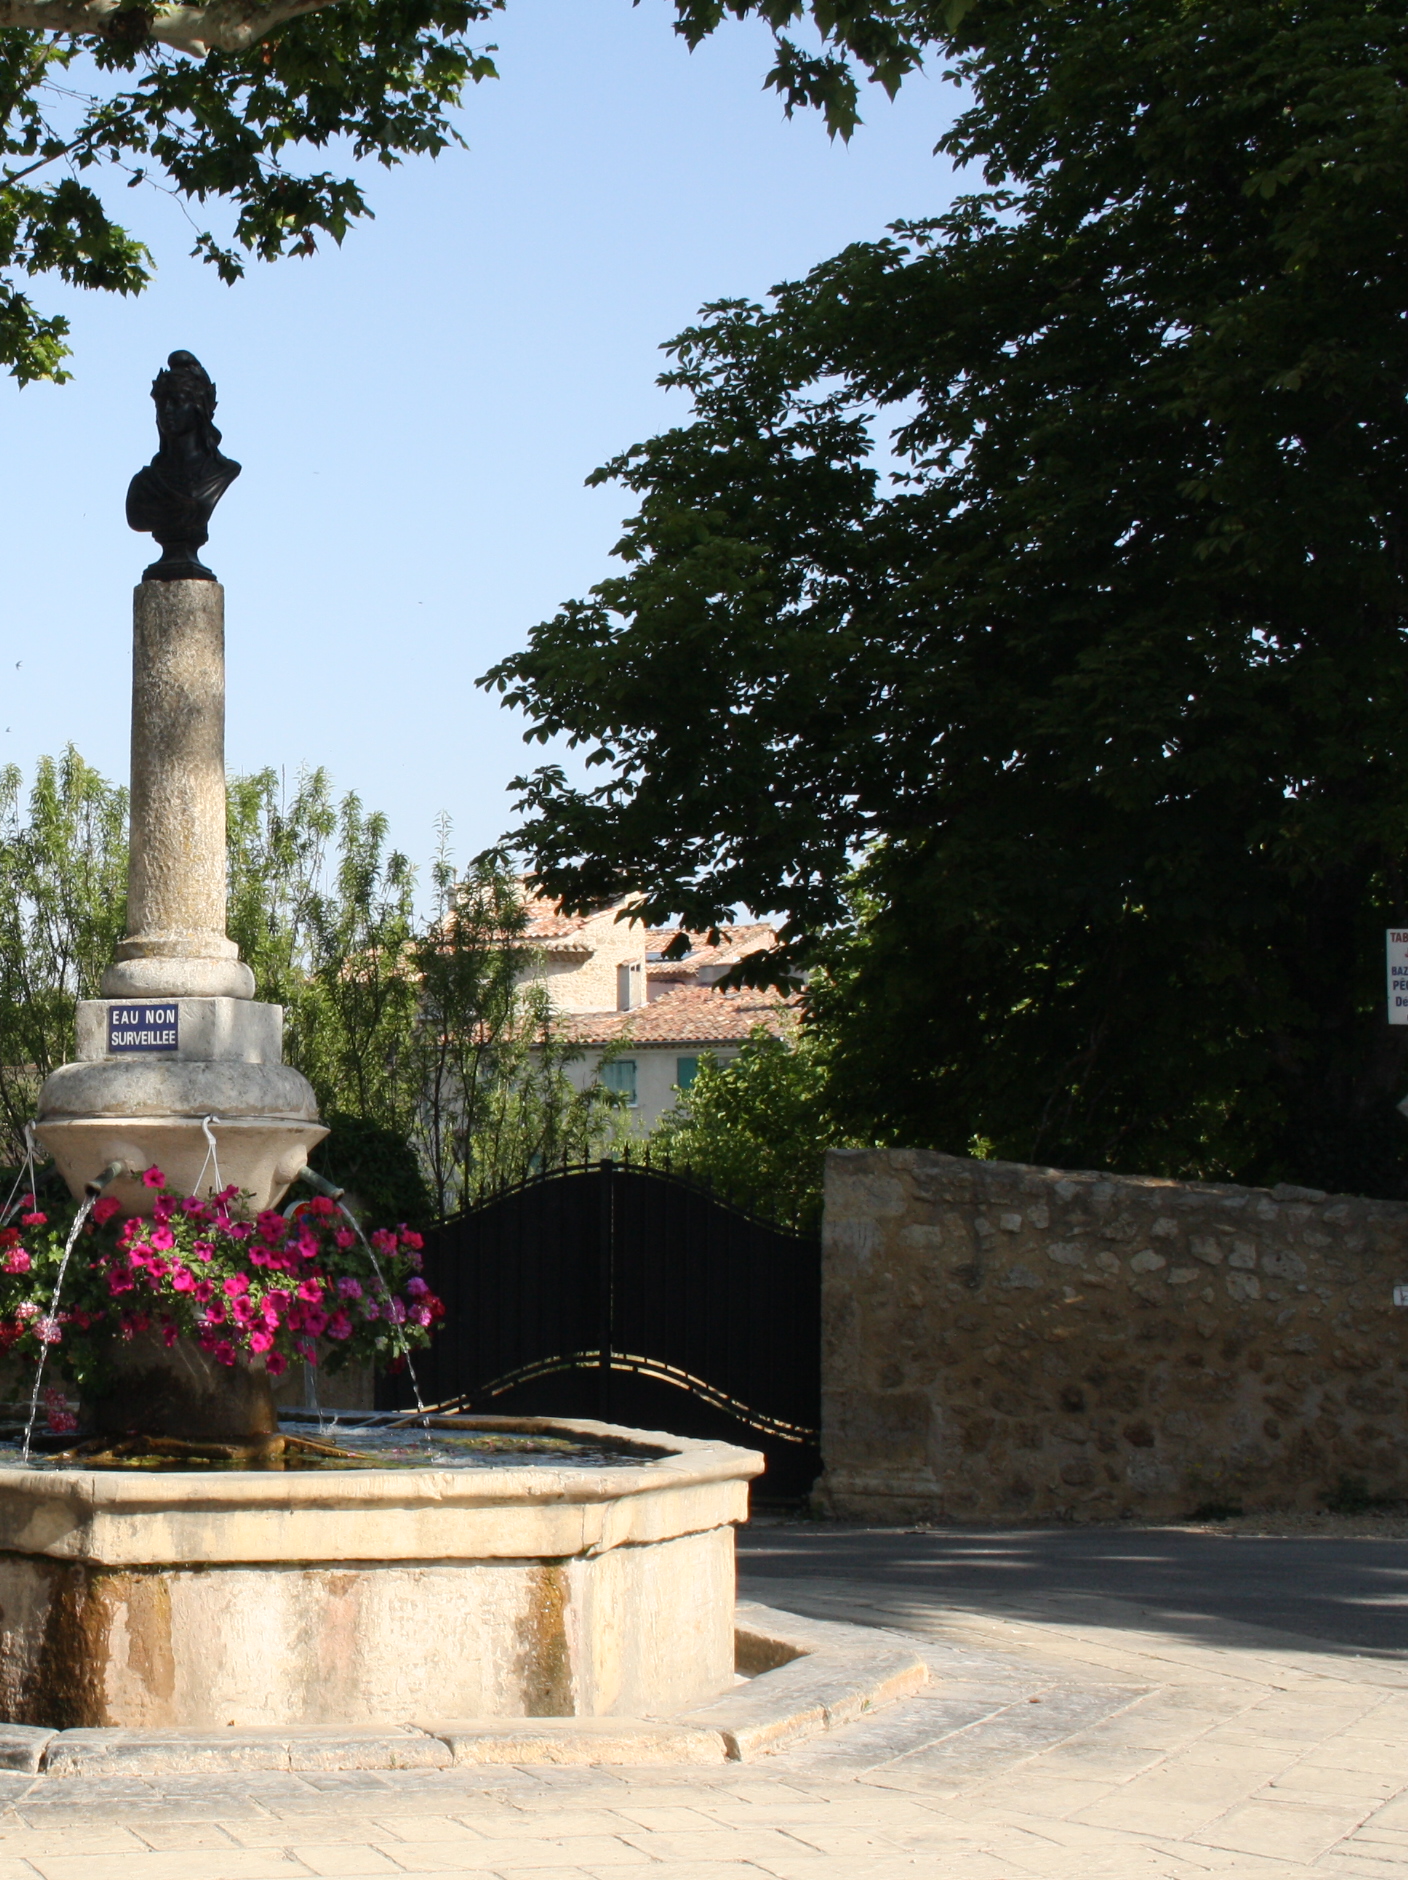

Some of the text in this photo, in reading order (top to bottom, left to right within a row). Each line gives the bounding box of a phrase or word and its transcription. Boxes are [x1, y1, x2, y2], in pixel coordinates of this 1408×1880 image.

[112, 1009, 175, 1024] EAU NON
[111, 1030, 176, 1046] SURVEILLEE
